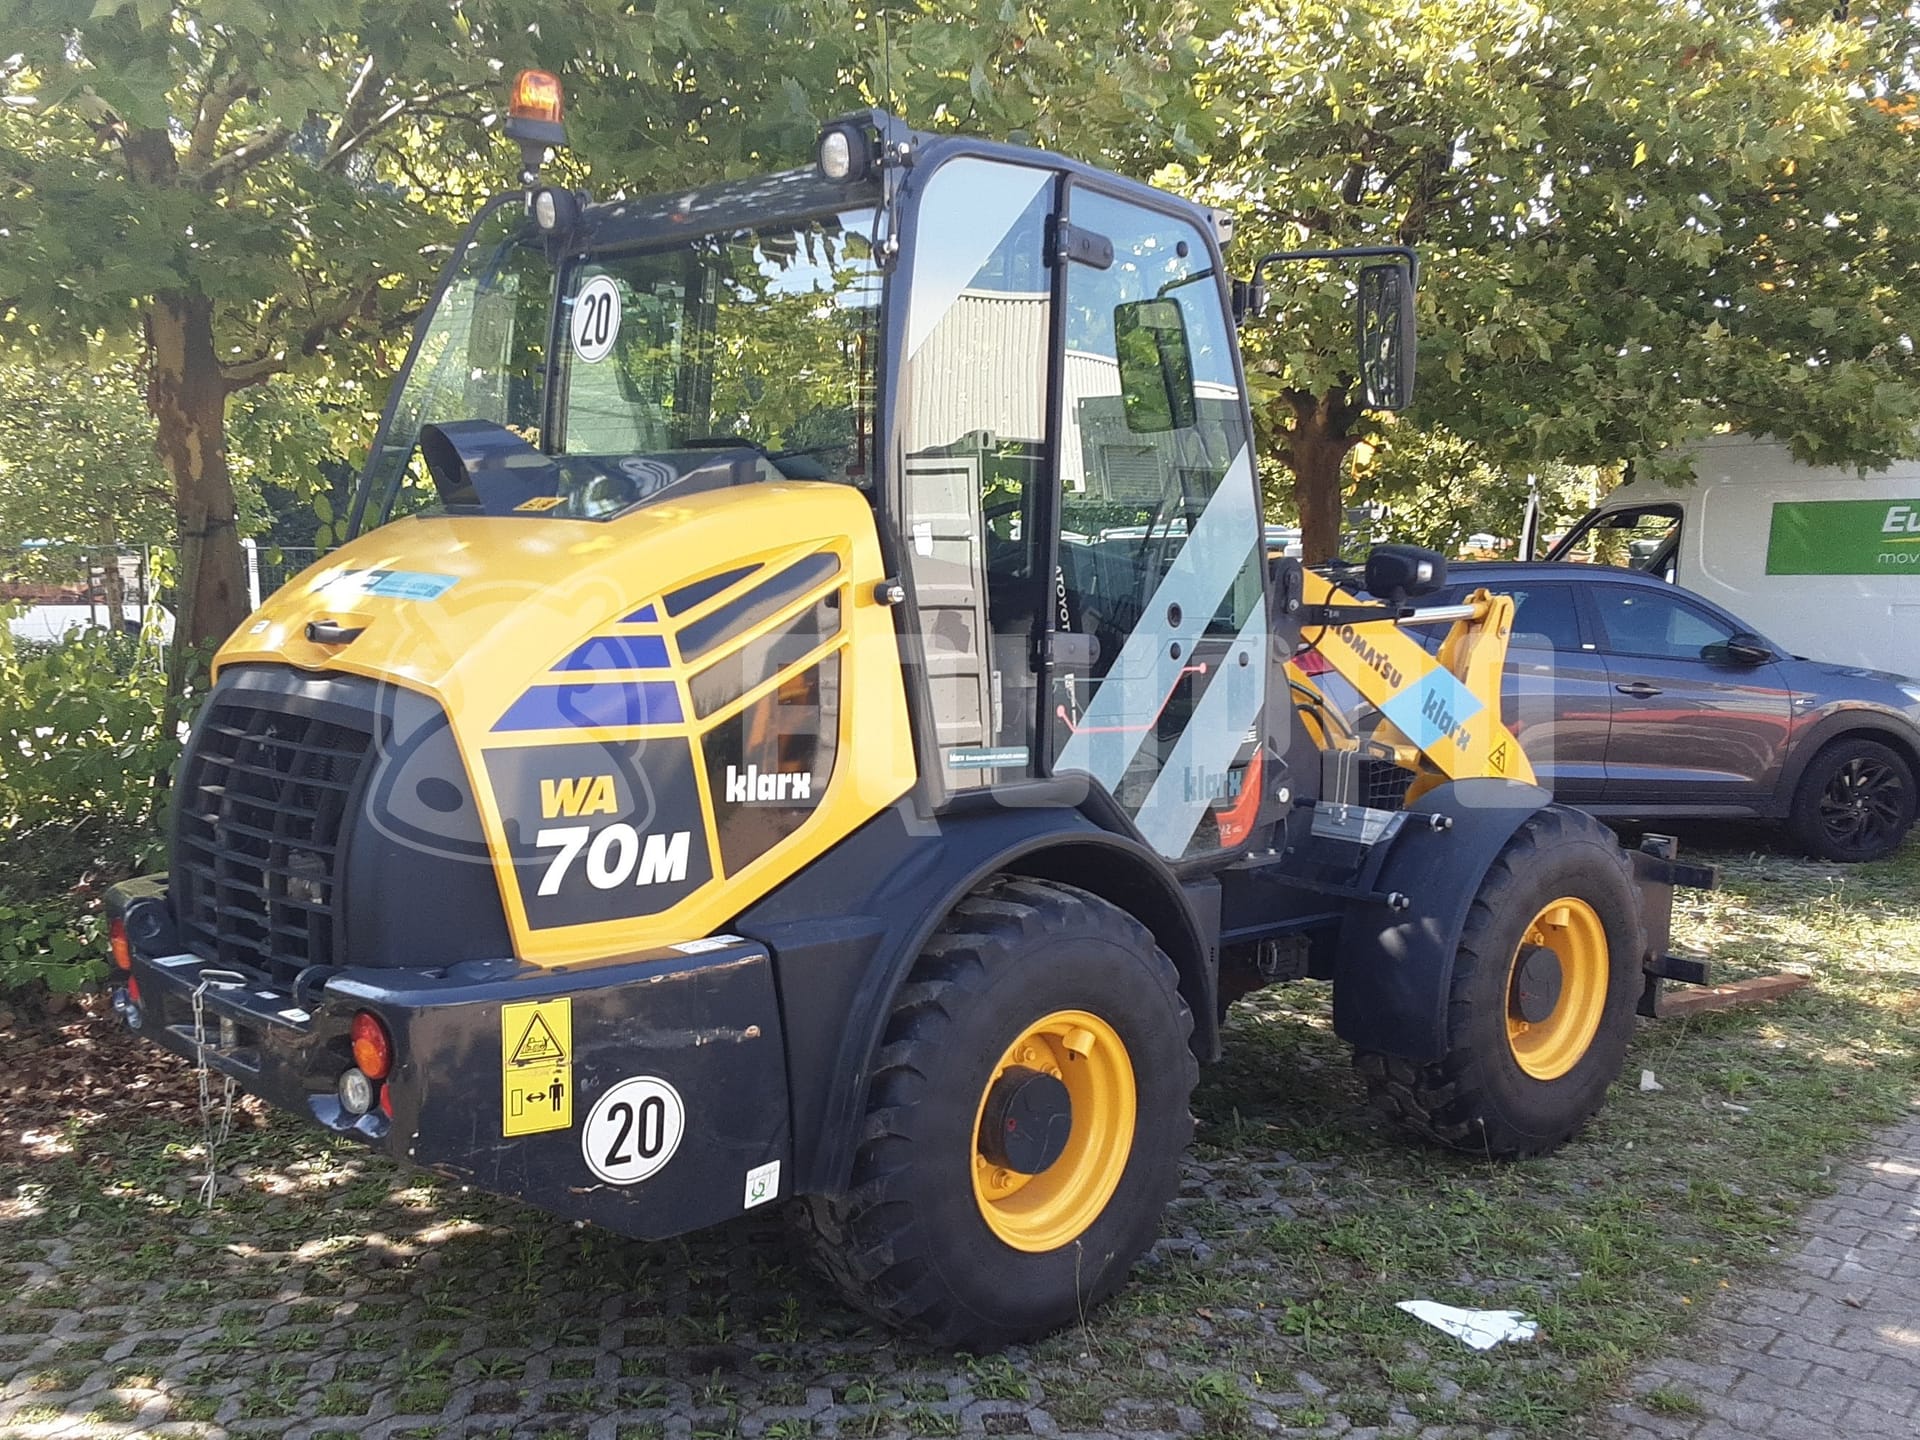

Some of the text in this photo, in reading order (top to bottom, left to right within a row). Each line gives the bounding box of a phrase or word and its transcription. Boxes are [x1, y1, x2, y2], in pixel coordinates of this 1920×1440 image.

[580, 292, 612, 347] 20
[1421, 687, 1472, 752] klarx
[539, 774, 619, 819] WA
[726, 764, 811, 803] klarx
[1183, 765, 1243, 803] klarx
[535, 822, 691, 897] 70M
[604, 1095, 666, 1168] 20
